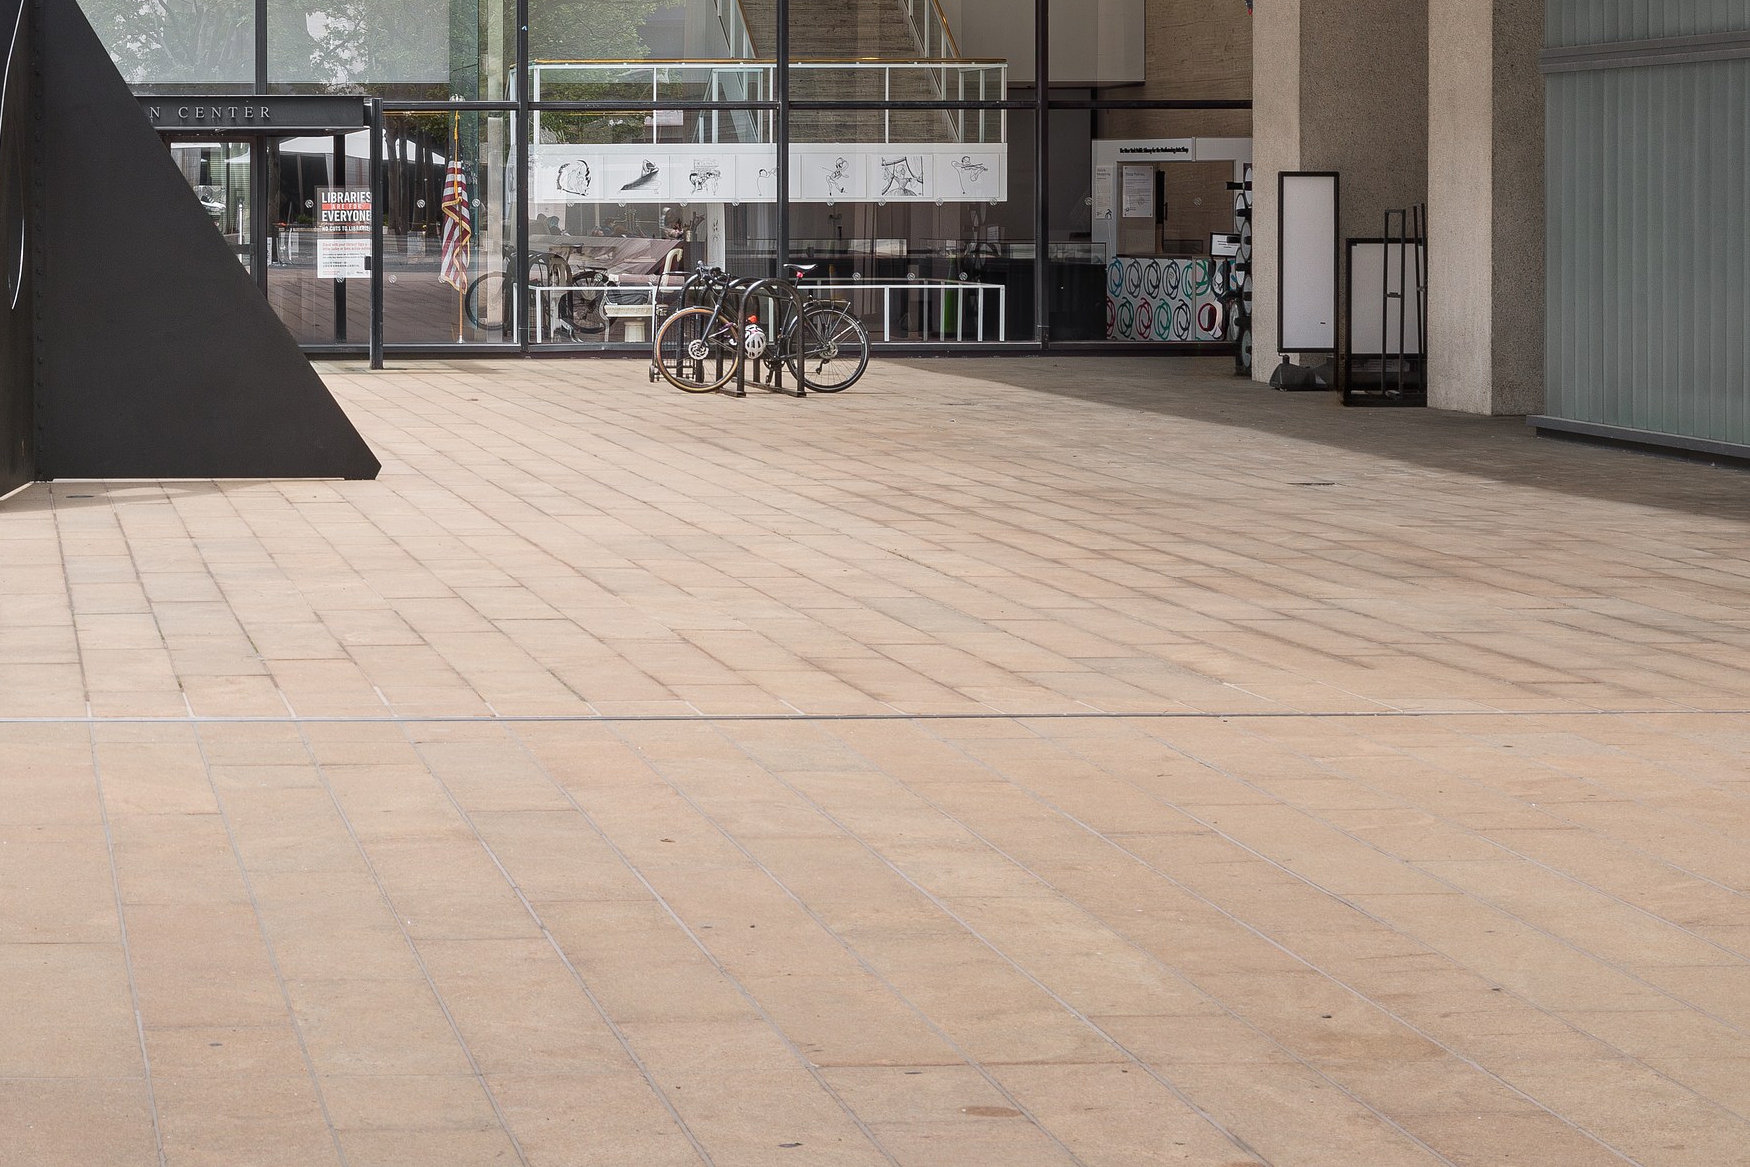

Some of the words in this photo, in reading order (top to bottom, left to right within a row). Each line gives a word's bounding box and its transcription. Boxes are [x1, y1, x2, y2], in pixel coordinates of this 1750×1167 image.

[177, 106, 270, 120] CENTER
[322, 192, 371, 203] LIBRARIES
[322, 210, 371, 221] EVERYONE
